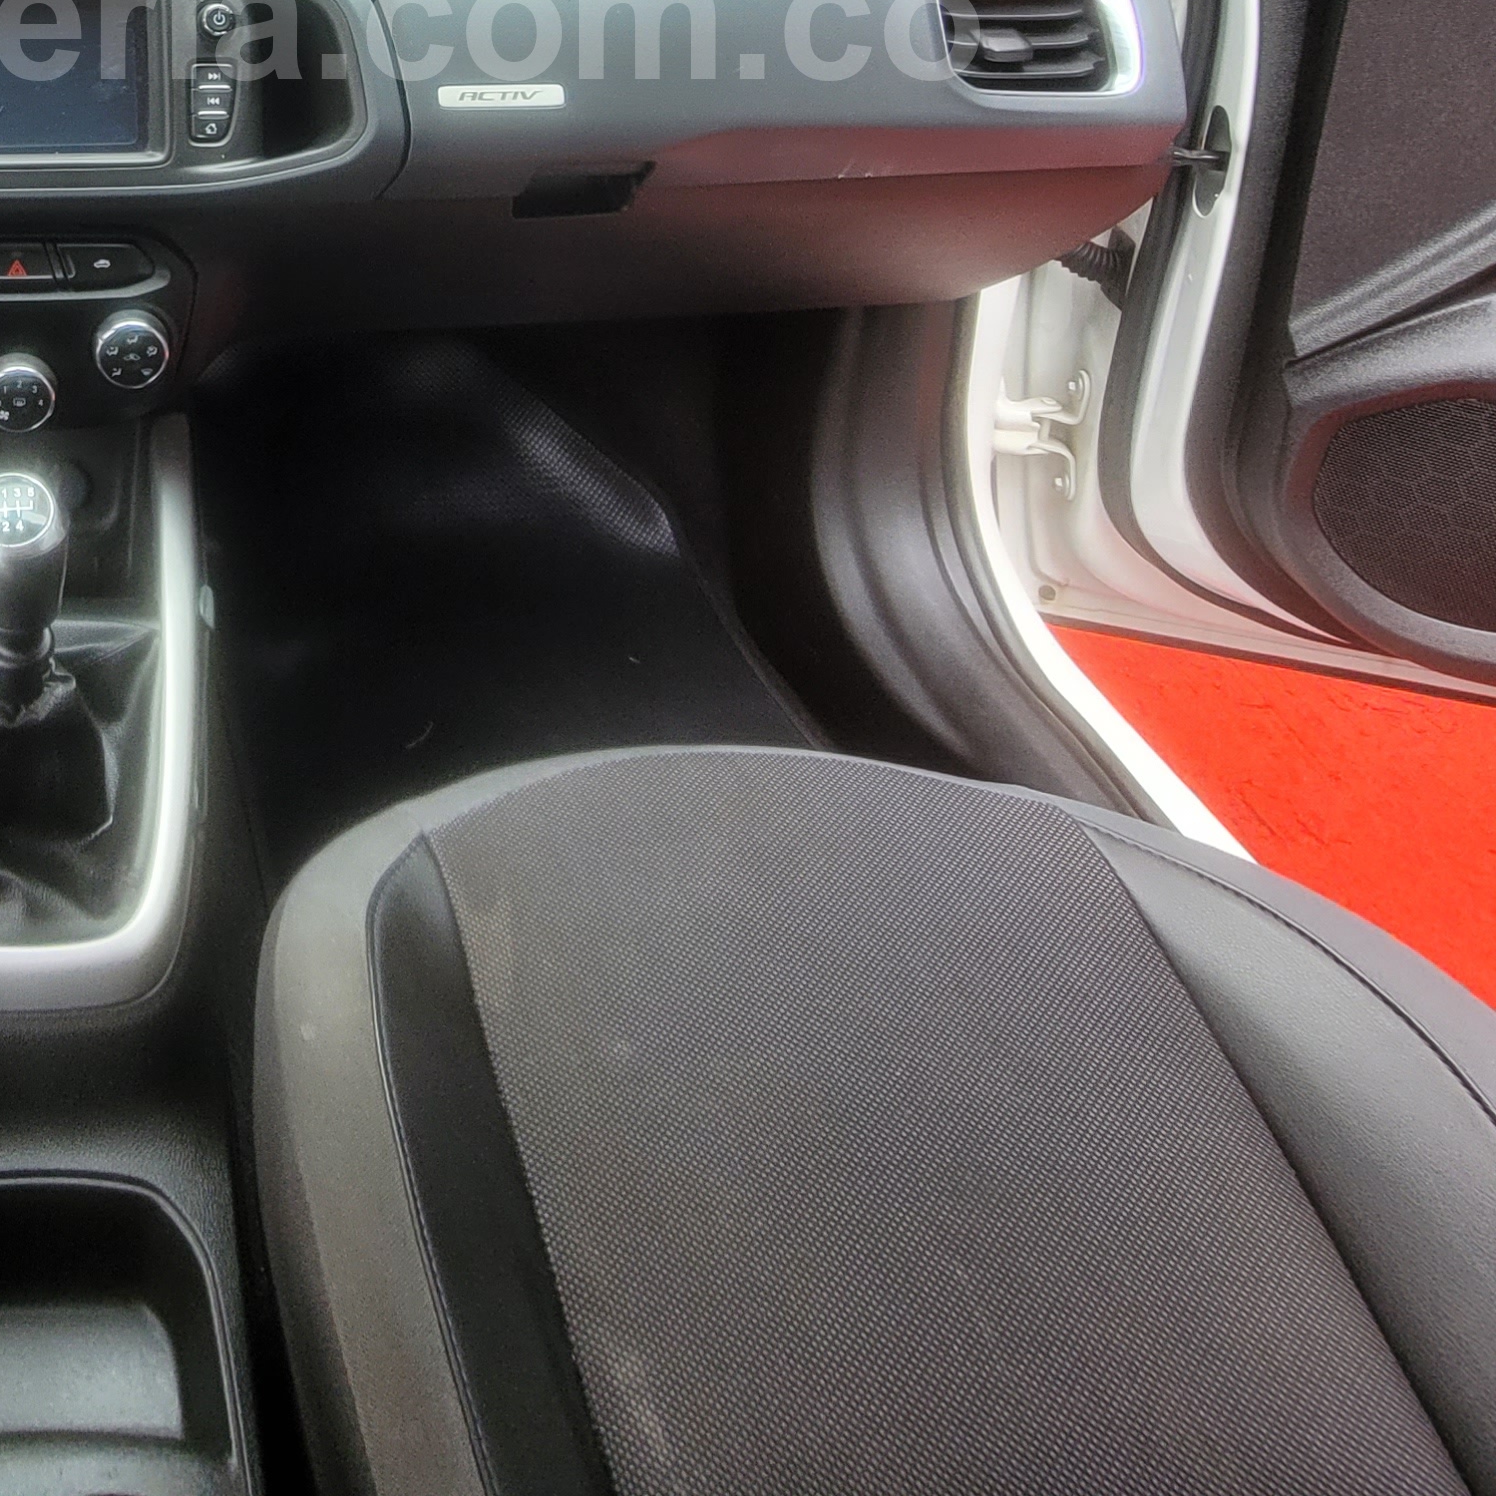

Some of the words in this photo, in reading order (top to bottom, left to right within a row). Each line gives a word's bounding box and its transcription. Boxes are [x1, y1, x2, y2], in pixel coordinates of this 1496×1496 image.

[458, 90, 544, 101] ACTIV
[32, 385, 38, 394] 3
[1, 488, 7, 499] 1
[13, 487, 21, 497] 3
[27, 487, 35, 497] 5
[2, 521, 10, 532] 2
[15, 519, 24, 531] 4
